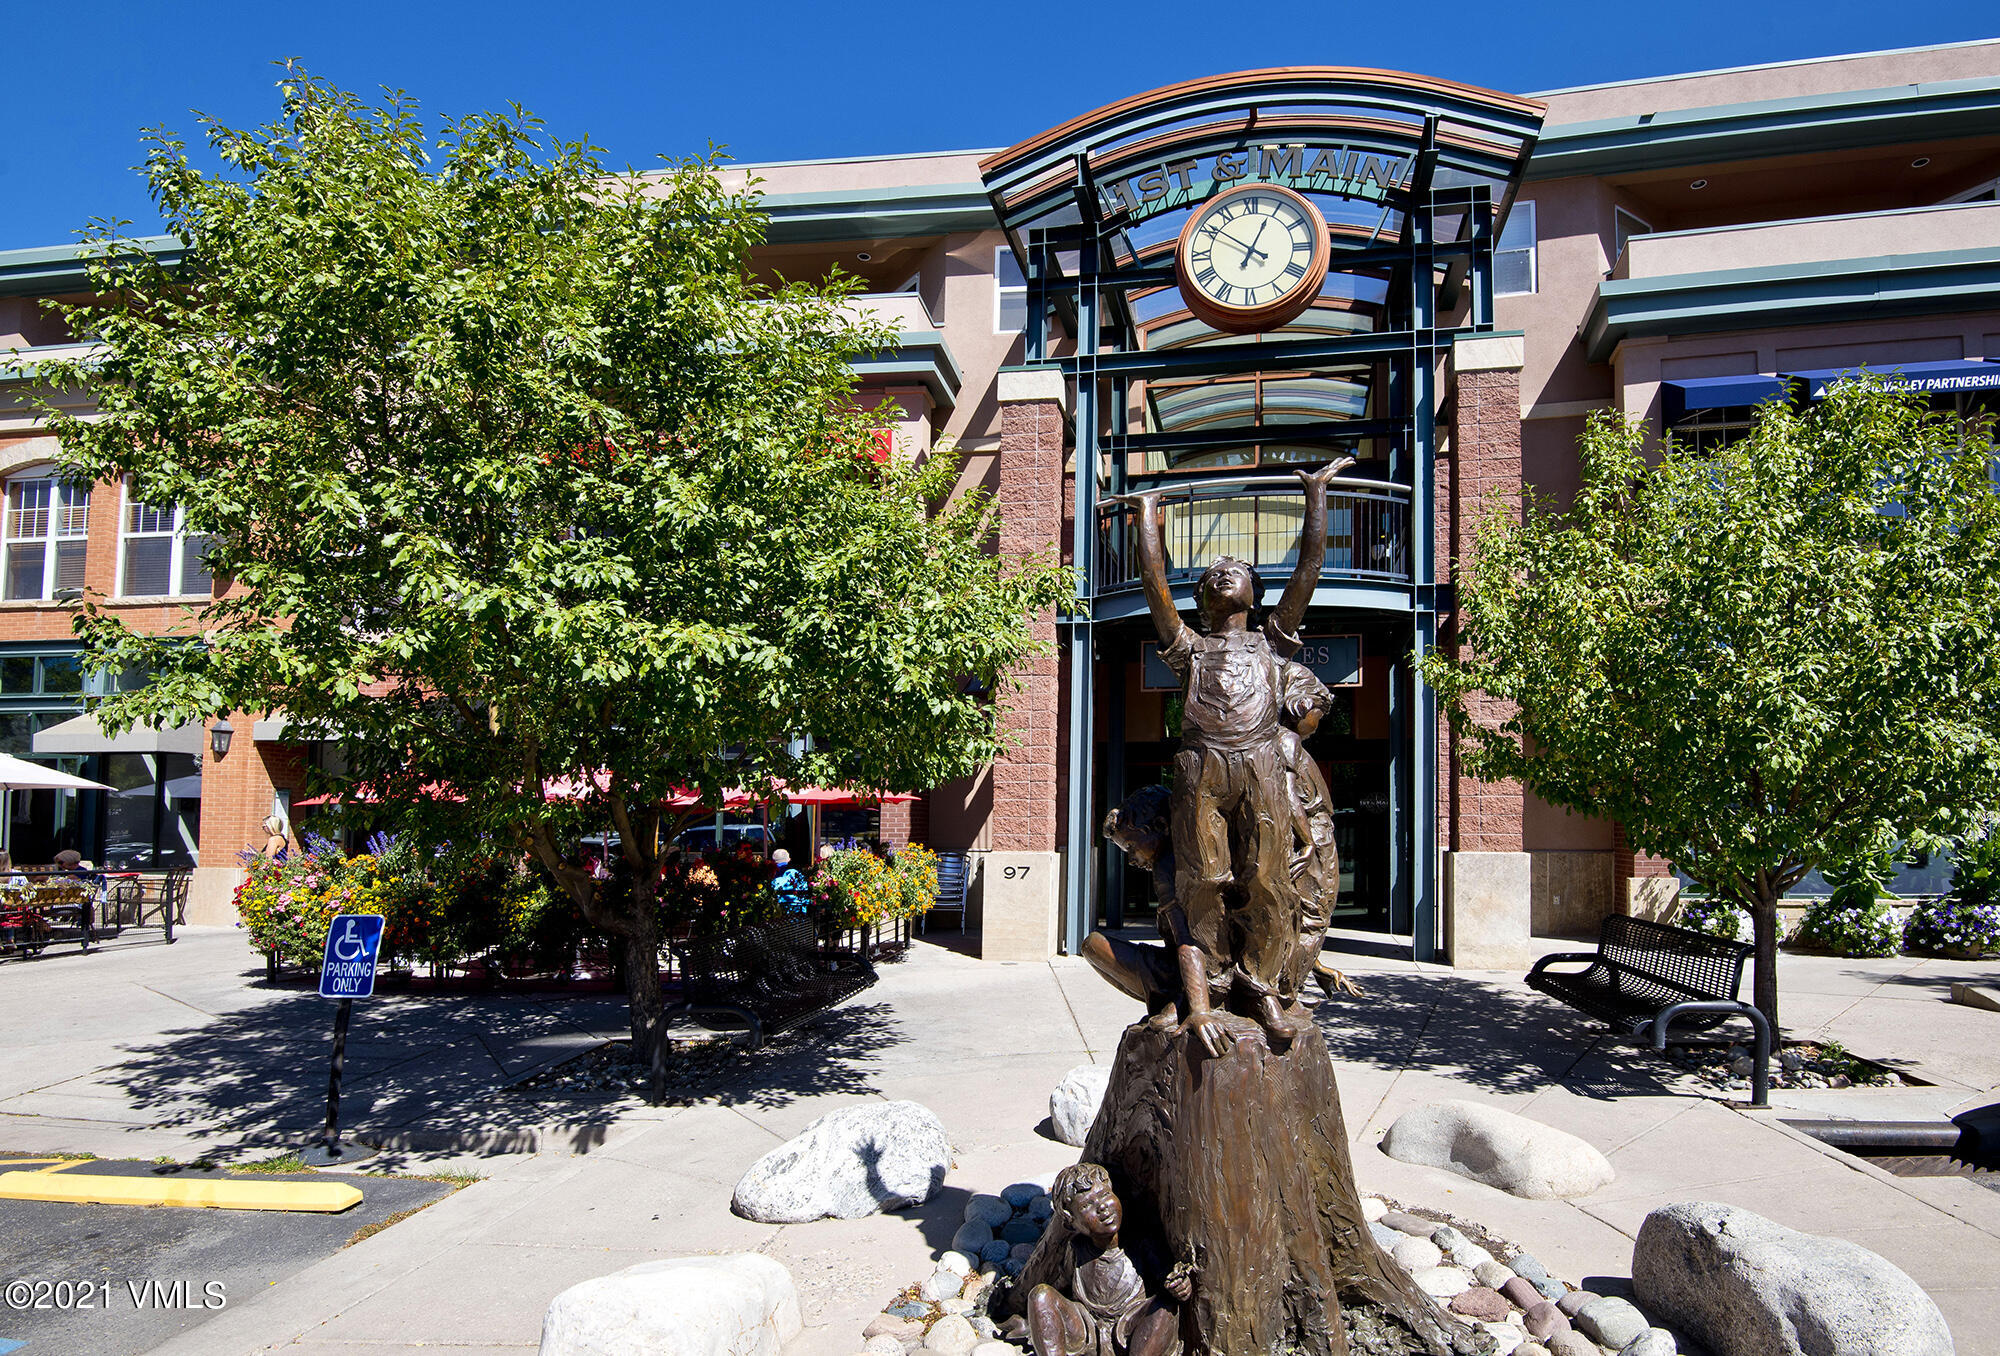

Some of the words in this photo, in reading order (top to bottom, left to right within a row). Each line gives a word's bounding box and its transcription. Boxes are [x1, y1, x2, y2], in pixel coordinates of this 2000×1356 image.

[1113, 159, 1198, 212] 1ST
[1211, 152, 1248, 181] &
[1258, 144, 1398, 189] MAIN
[1926, 374, 2000, 390] PARTNERSHI
[1003, 866, 1030, 880] 97
[326, 962, 372, 977] PARKING
[332, 977, 362, 993] ONLY
